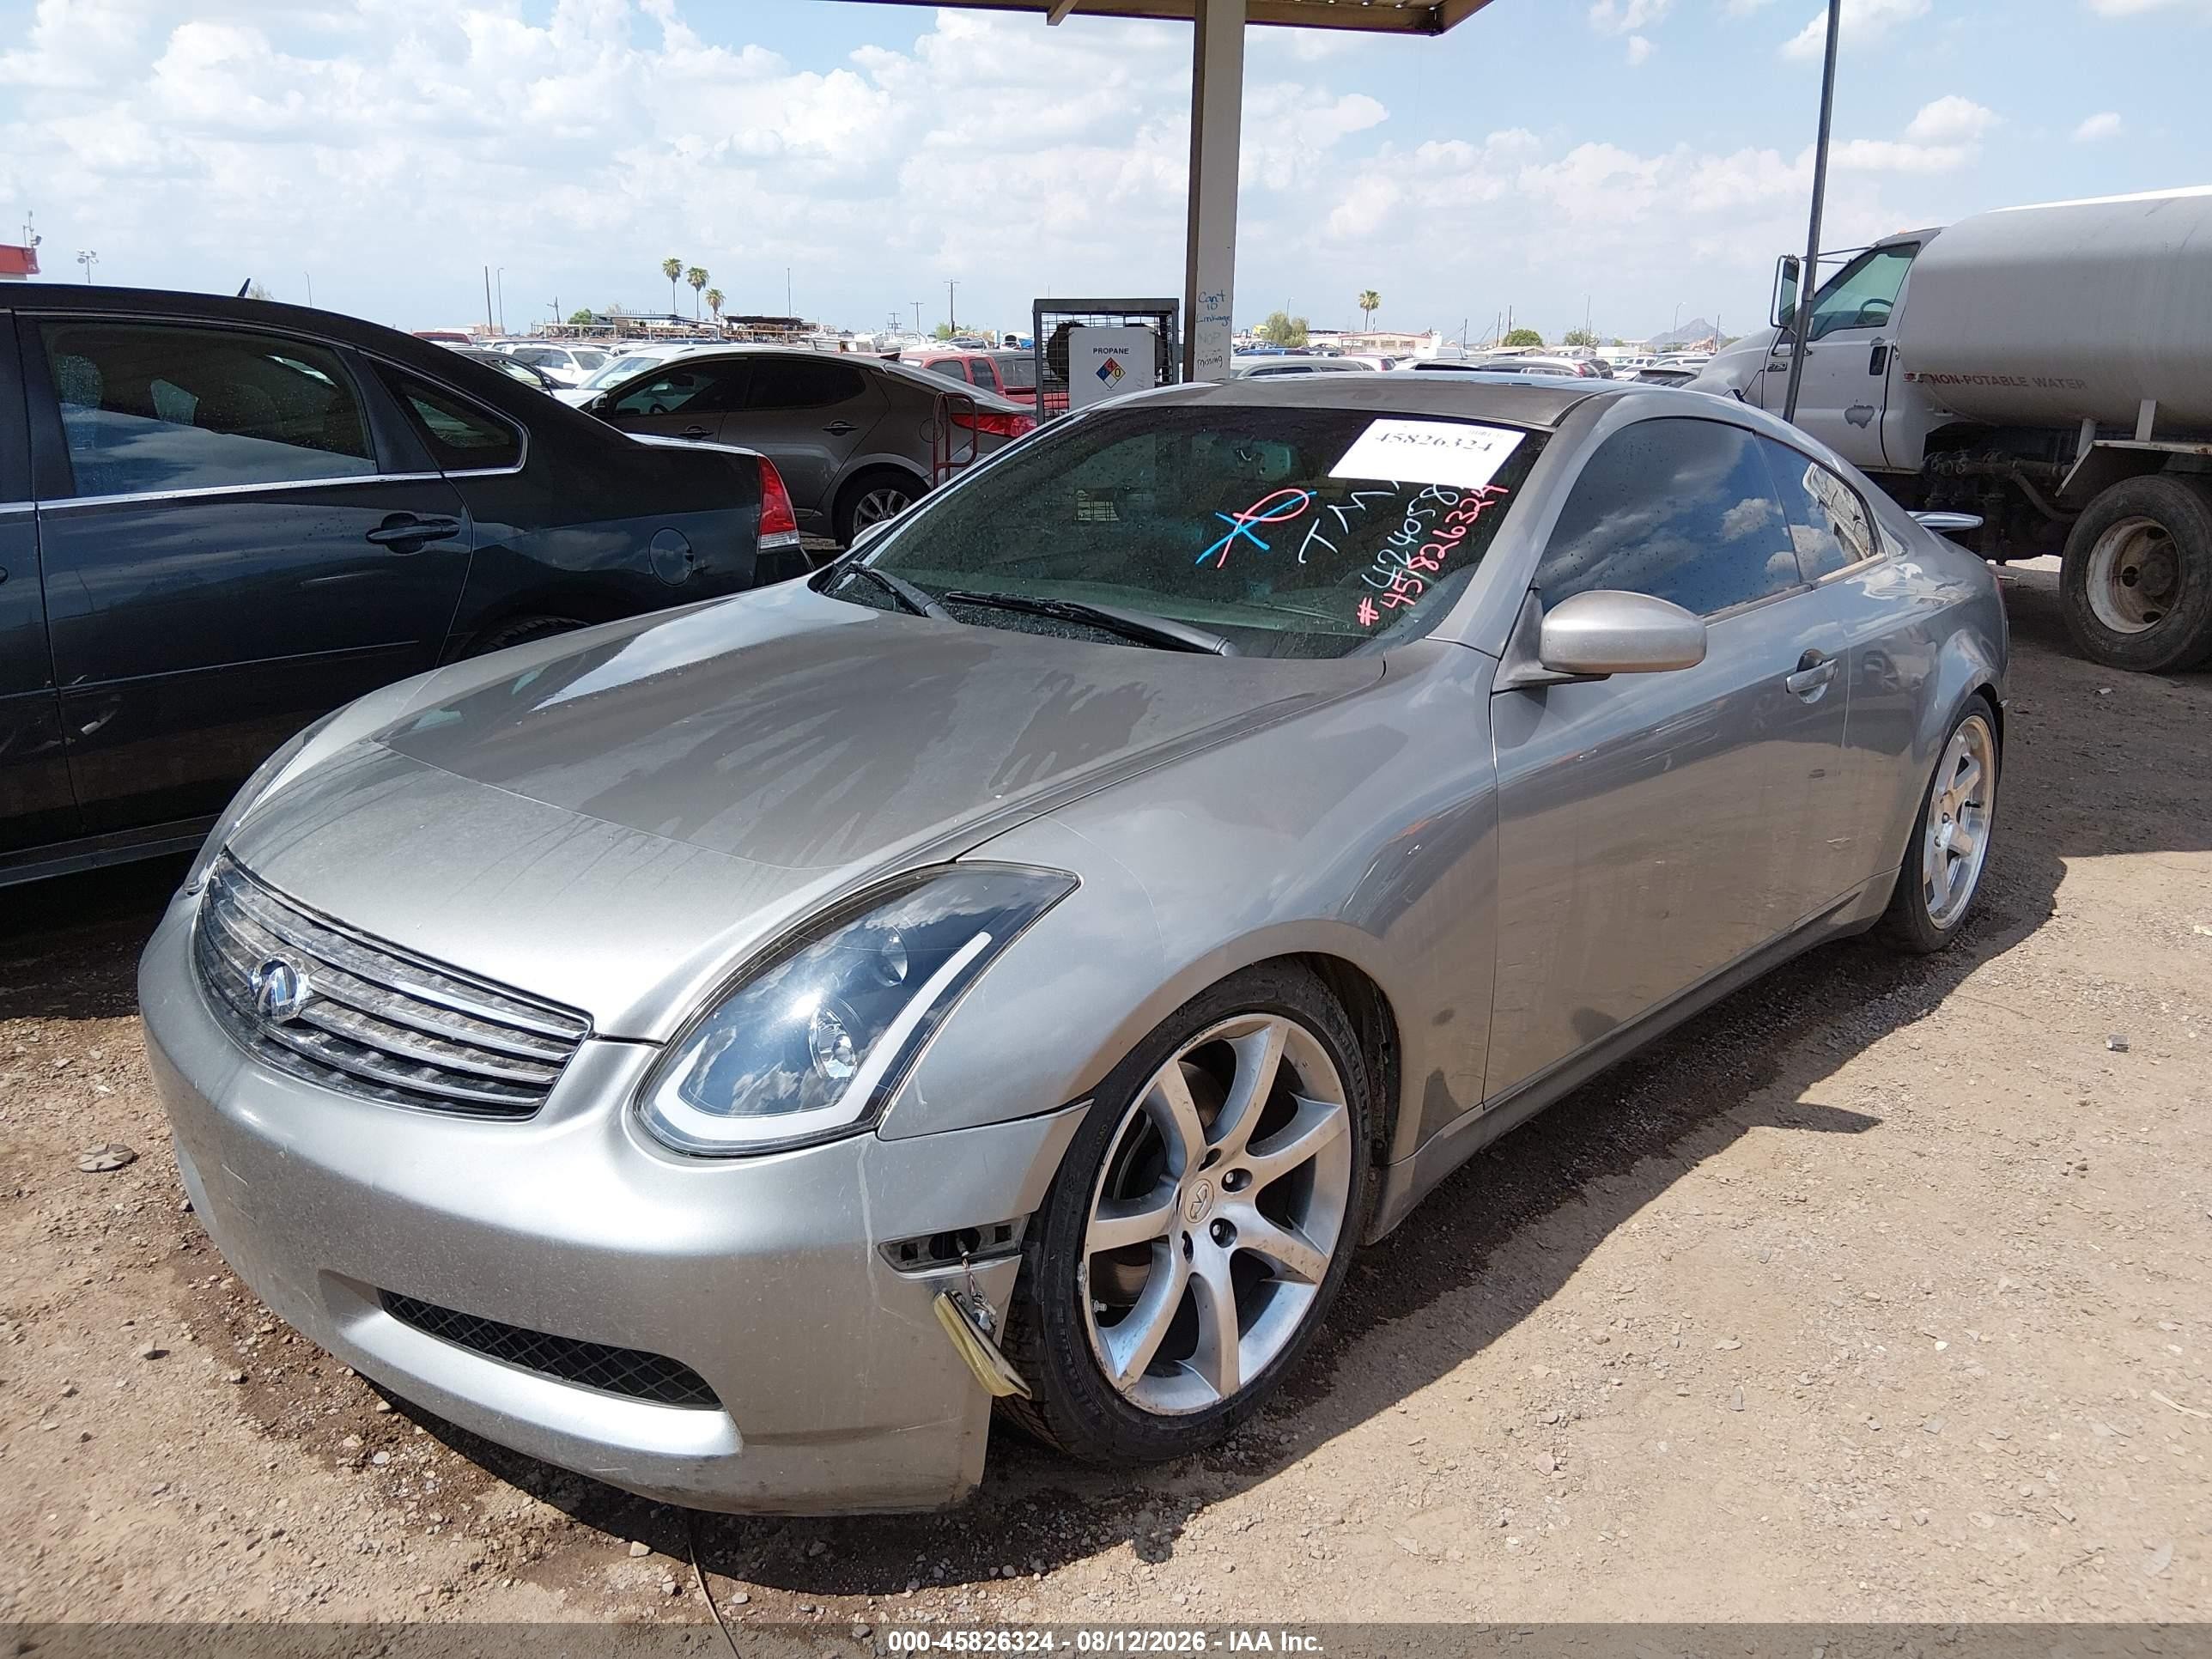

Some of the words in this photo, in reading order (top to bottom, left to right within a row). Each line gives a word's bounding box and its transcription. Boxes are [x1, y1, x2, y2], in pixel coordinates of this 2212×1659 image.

[1107, 361, 1115, 369] 4
[1115, 368, 1121, 378] 0
[1929, 374, 2029, 387] NON-POTABLE
[2033, 377, 2088, 390] WATER
